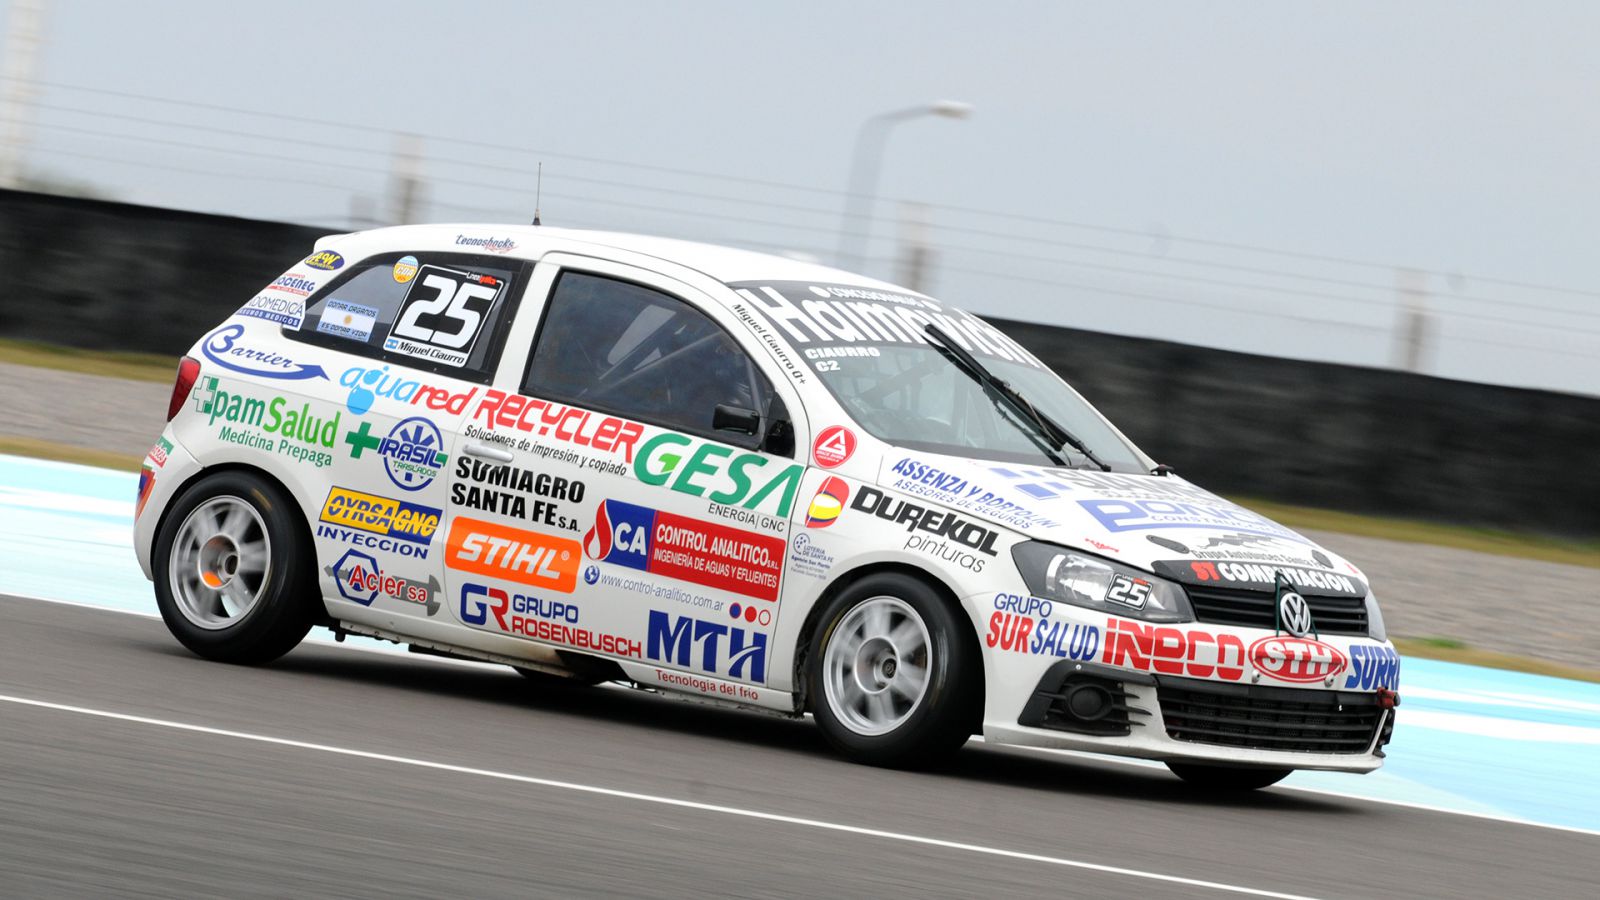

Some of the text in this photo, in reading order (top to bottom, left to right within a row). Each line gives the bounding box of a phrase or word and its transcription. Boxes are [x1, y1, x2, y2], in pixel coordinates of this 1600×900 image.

[265, 311, 299, 326] MEDICOS
[394, 274, 498, 349] 25
[203, 324, 293, 369] Barrier
[398, 341, 465, 365] Miguel Ciaurro
[732, 304, 767, 334] Miguel
[762, 334, 794, 369] Ciaurro
[804, 347, 880, 359] CIAURRO
[815, 360, 841, 372] C2
[219, 426, 332, 467] Medicina Prepaga
[465, 425, 627, 476] Soluciones de impresión y copiado
[393, 460, 437, 478] TRASLADOS
[456, 456, 585, 503] SUMIAGRO
[892, 457, 968, 495] ASSENZA
[965, 485, 982, 498] Y
[451, 483, 526, 520] SANTA
[532, 500, 558, 526] FE
[708, 503, 785, 532] ENERGIA GNC
[850, 485, 999, 557] DUREKOL
[893, 479, 1033, 530] ASESORES DE SEGUROS
[316, 525, 429, 560] INYECCION
[456, 532, 560, 579] STIHL
[614, 522, 647, 555] CA
[656, 524, 708, 552] CONTROL
[710, 537, 769, 567] ANALITICO
[904, 533, 986, 573] pinturas
[349, 565, 428, 602] Acier sa
[694, 557, 706, 571] DE
[705, 560, 730, 577] AGUAS
[731, 566, 738, 578] Y
[737, 567, 777, 588] EFLUENTES
[512, 594, 579, 624] GRUPO
[601, 574, 724, 612] www.control-analitico.com.ar
[994, 592, 1053, 618] GRUPO
[1108, 578, 1149, 606] 25
[512, 616, 642, 658] ROSENBUSCH
[1262, 641, 1333, 676] STH
[719, 683, 736, 695] del
